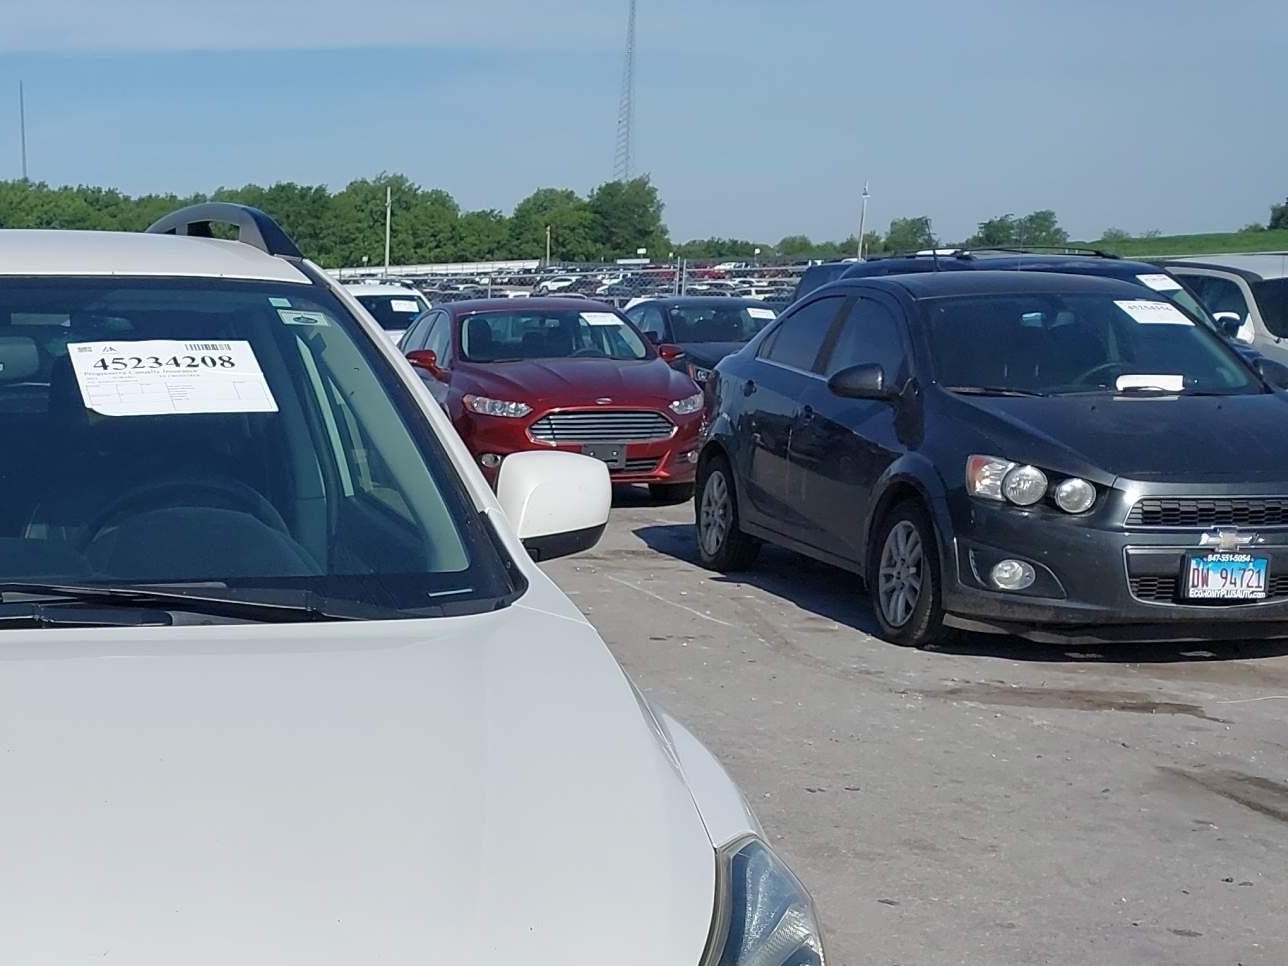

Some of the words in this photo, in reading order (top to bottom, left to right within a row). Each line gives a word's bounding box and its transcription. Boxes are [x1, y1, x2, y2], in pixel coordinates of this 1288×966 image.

[93, 355, 236, 371] 45234208
[1191, 567, 1210, 589] DW
[1220, 567, 1263, 589] 94721
